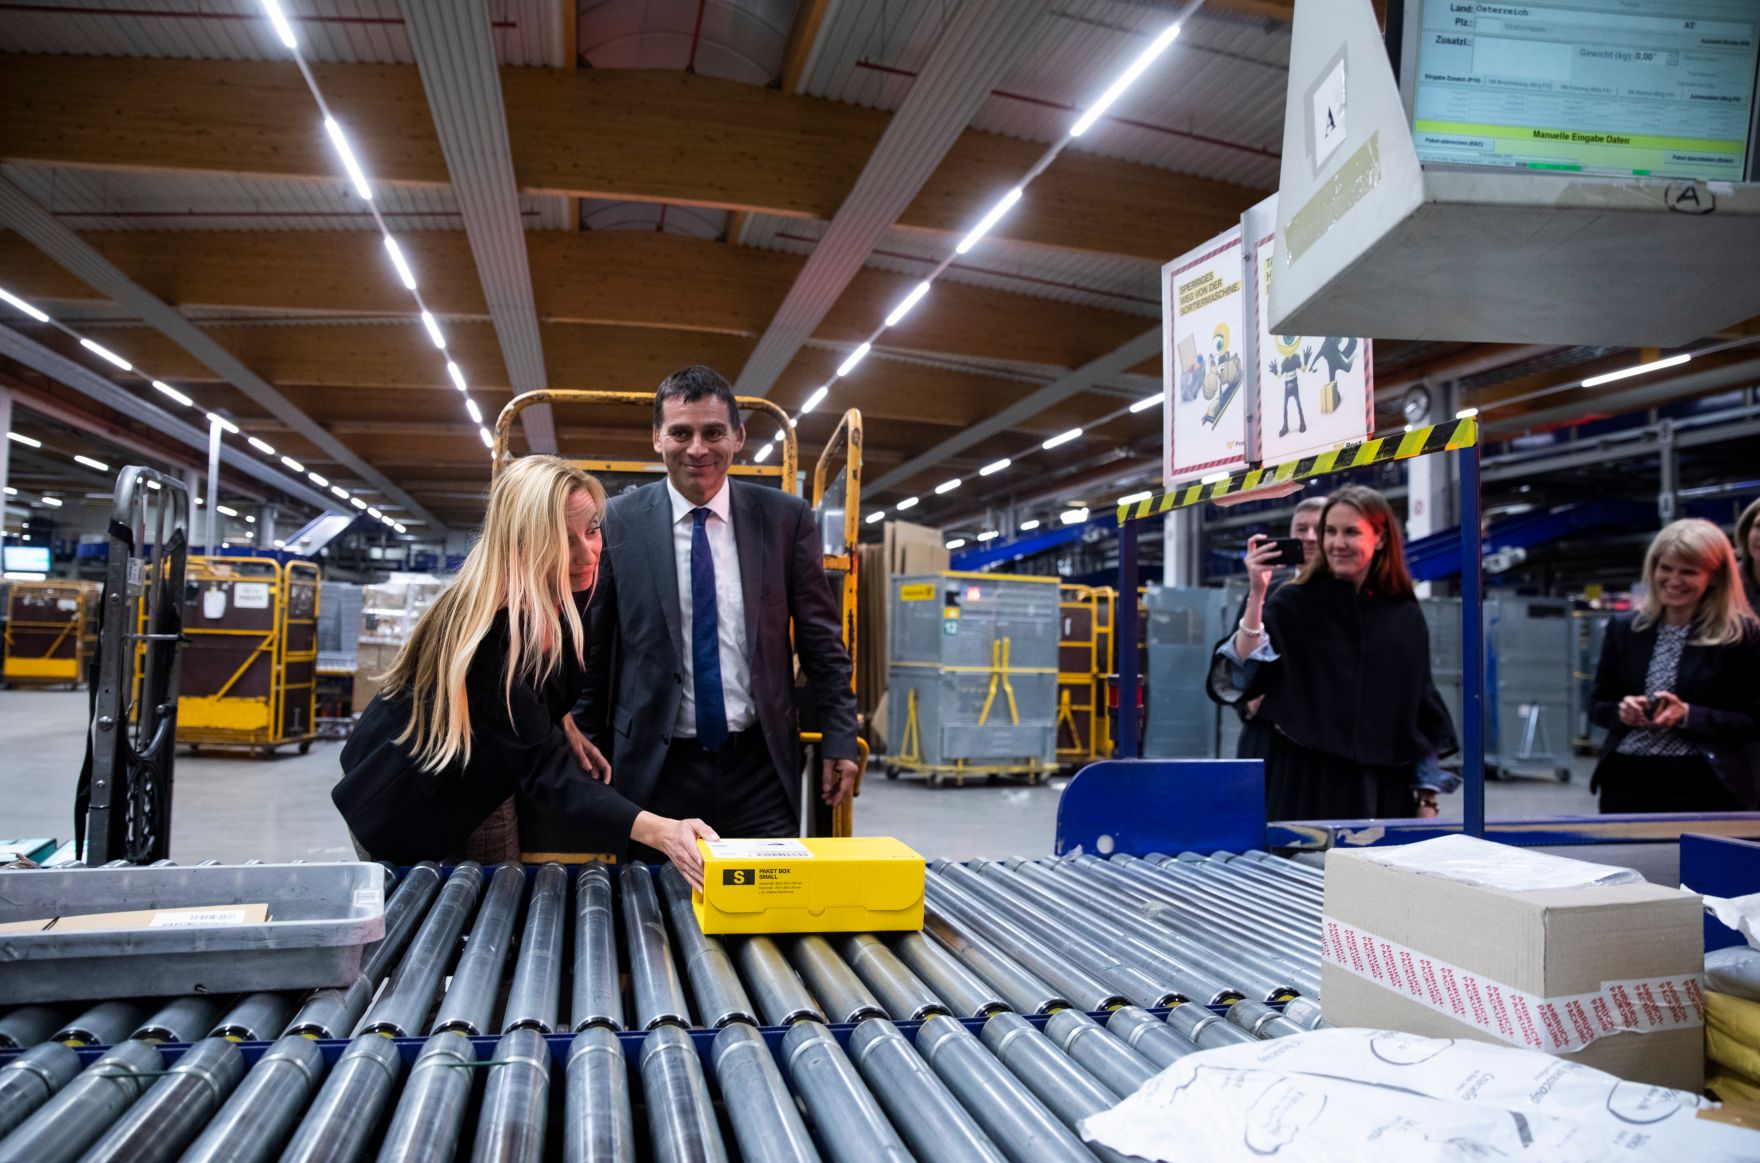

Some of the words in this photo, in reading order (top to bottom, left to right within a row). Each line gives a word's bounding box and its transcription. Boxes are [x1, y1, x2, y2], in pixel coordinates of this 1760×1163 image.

[1450, 3, 1474, 14] Land:
[1455, 18, 1473, 27] Plz.:
[1579, 49, 1613, 60] Gewicht
[1324, 106, 1336, 138] A
[1533, 130, 1570, 140] Manuelle
[1572, 131, 1605, 144] Eingabe
[1606, 133, 1630, 144] Daten
[1676, 186, 1700, 207] A
[1180, 271, 1214, 294] SPERRIGES
[1180, 293, 1194, 305] WEG
[1196, 286, 1208, 298] VON
[1209, 279, 1223, 292] DER
[1180, 282, 1240, 316] SORTIERMASCHINE.
[734, 870, 745, 884] S
[1328, 922, 1342, 963] PACKUNG
[1344, 930, 1359, 971] PACKUNG
[1362, 936, 1378, 978] PACKUNG
[1380, 944, 1396, 986] PACKUNG
[1400, 952, 1416, 995] PACKUNG
[1420, 960, 1438, 1004] PACKUNG
[1440, 968, 1460, 1014] PACKUNG
[1462, 976, 1482, 1024] PACKUNG
[1486, 985, 1506, 1034] PACKUNG
[1510, 994, 1532, 1045] PACKUNG
[1536, 1004, 1562, 1048] PACKUNG
[1565, 1002, 1588, 1044] PACKUNG
